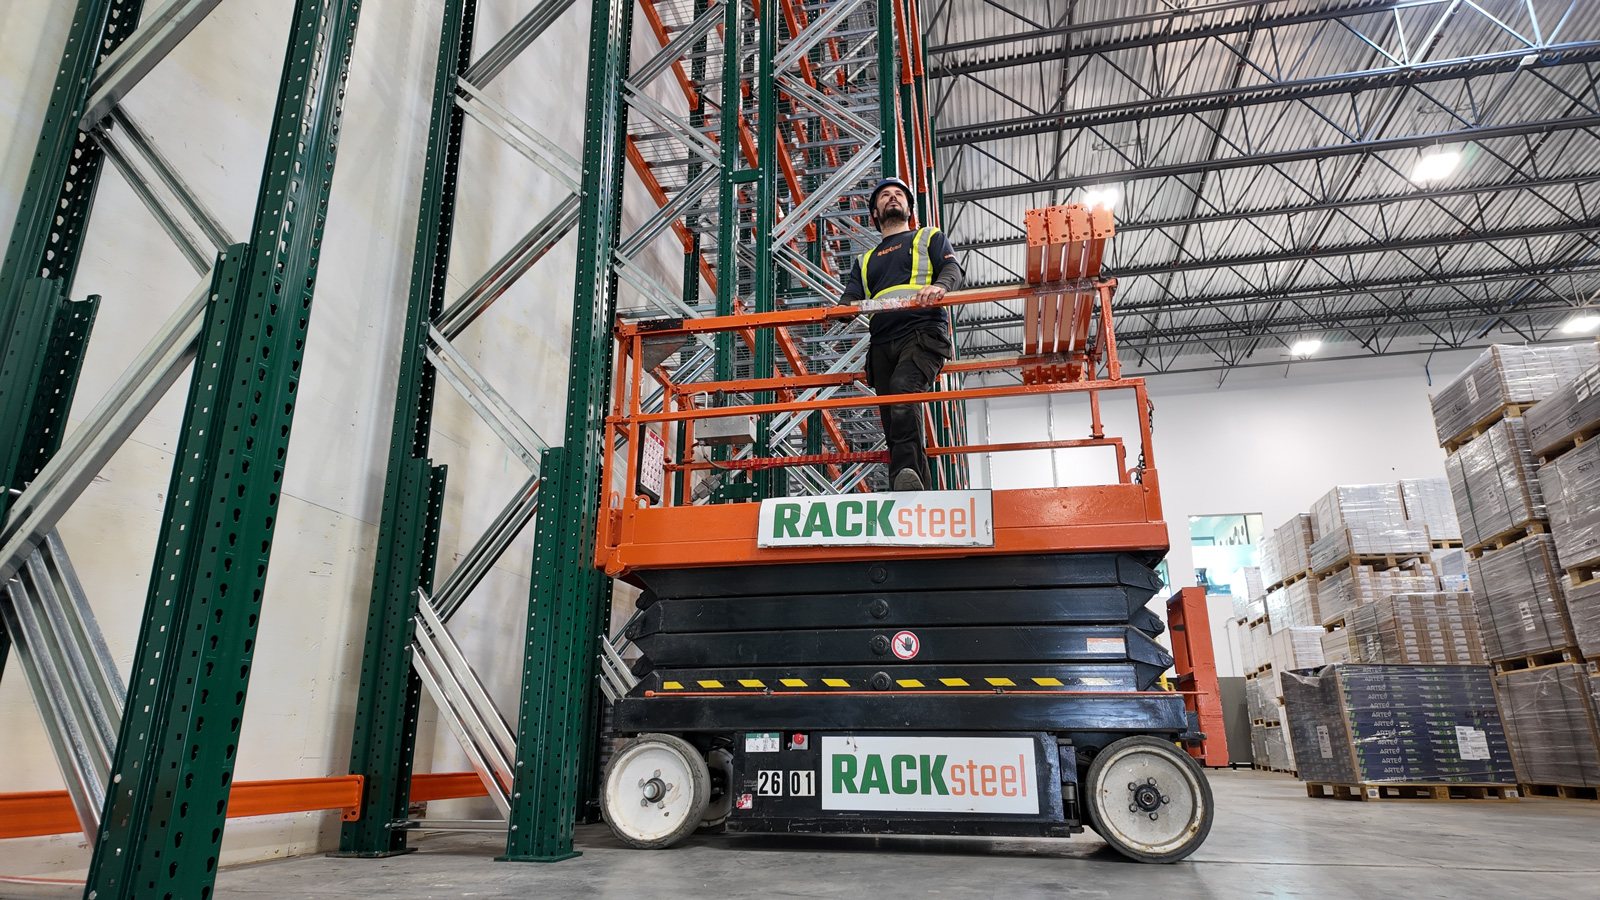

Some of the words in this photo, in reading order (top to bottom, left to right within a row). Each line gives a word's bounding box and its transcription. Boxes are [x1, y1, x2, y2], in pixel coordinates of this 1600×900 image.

[773, 497, 976, 539] RACKsteel
[759, 771, 781, 795] 26
[791, 771, 812, 795] 01
[832, 753, 1027, 797] RACKsteel
